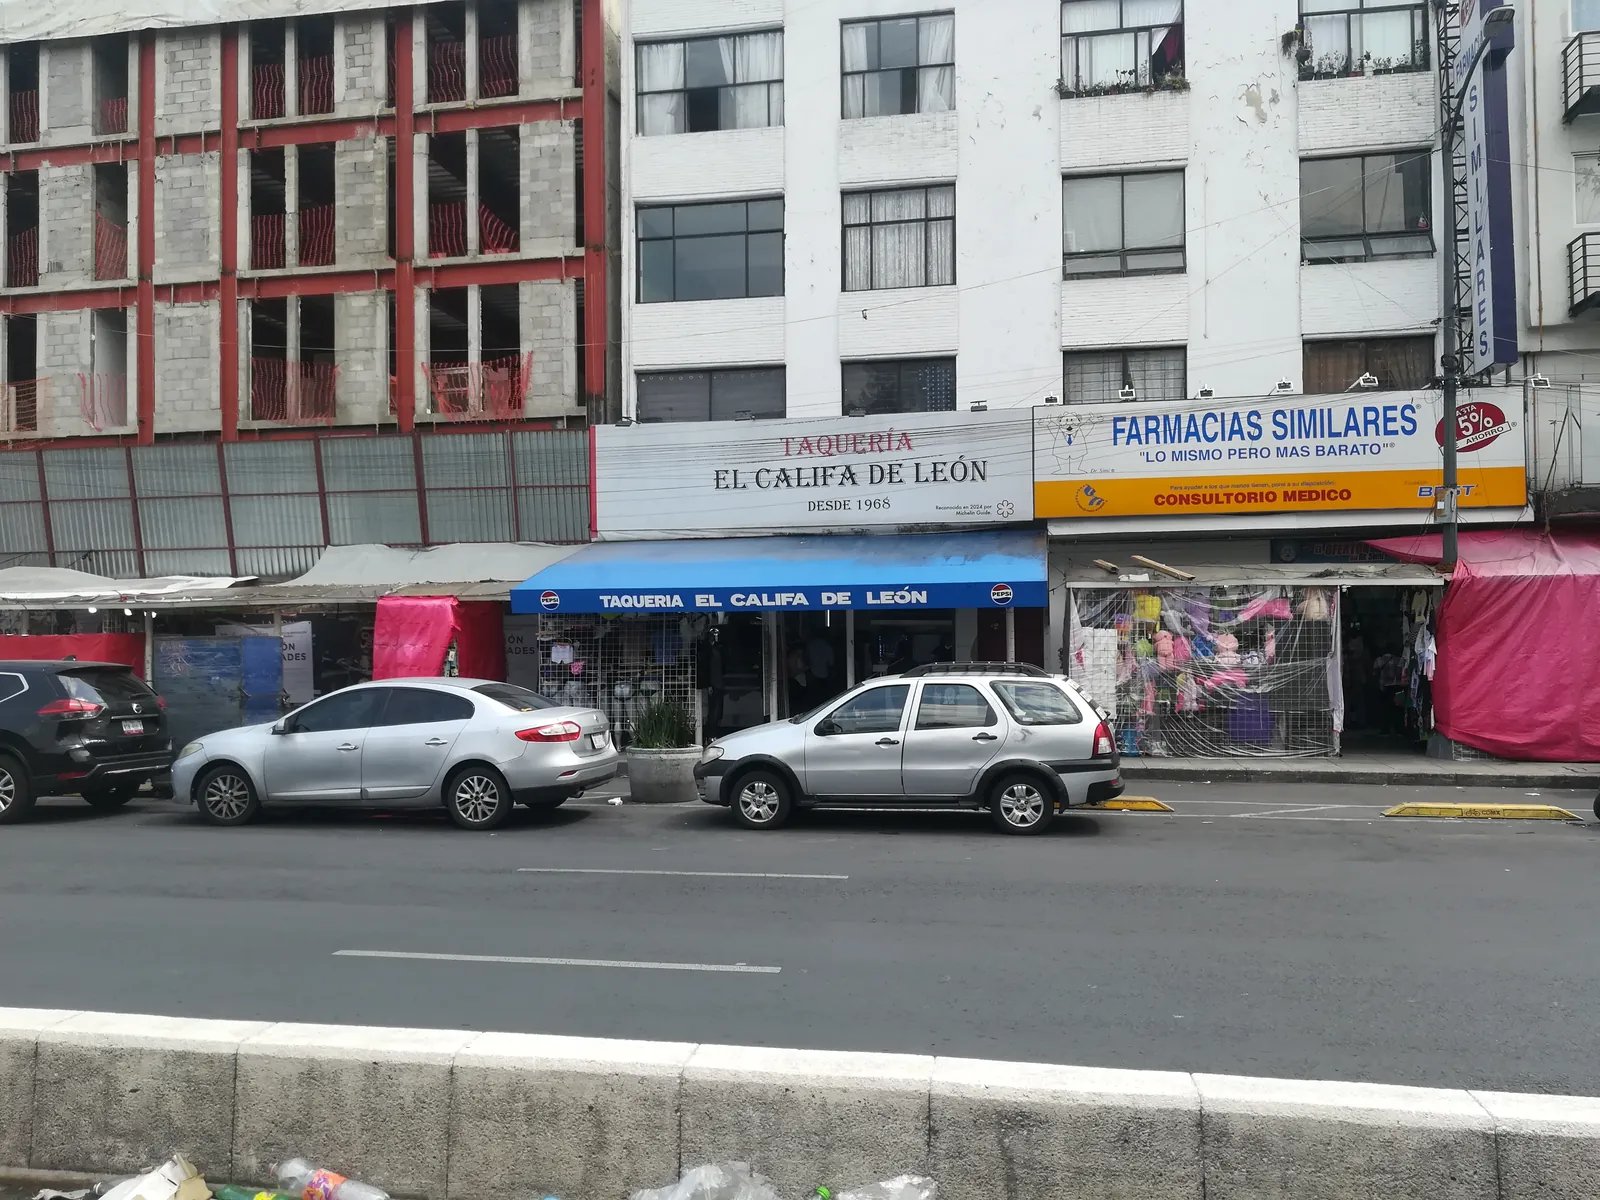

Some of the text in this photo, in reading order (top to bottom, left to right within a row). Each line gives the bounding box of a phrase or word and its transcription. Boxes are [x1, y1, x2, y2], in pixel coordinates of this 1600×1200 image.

[1469, 85, 1490, 357] SIMILARES
[1112, 404, 1417, 446] FARMACIAS SIMILARES
[1466, 426, 1504, 445] AHORRO
[779, 427, 913, 457] TAQUERÍA
[1171, 449, 1222, 462] MISMO
[1228, 447, 1271, 460] PERO
[1276, 445, 1310, 458] MAS
[714, 455, 987, 490] EL CALIFA DE LEÓN
[808, 497, 891, 512] DESDE 1968
[1154, 488, 1352, 507] CONSULTORIO MEDICO
[600, 586, 927, 608] TAQUERIA EL CALIFA DE LEÓN
